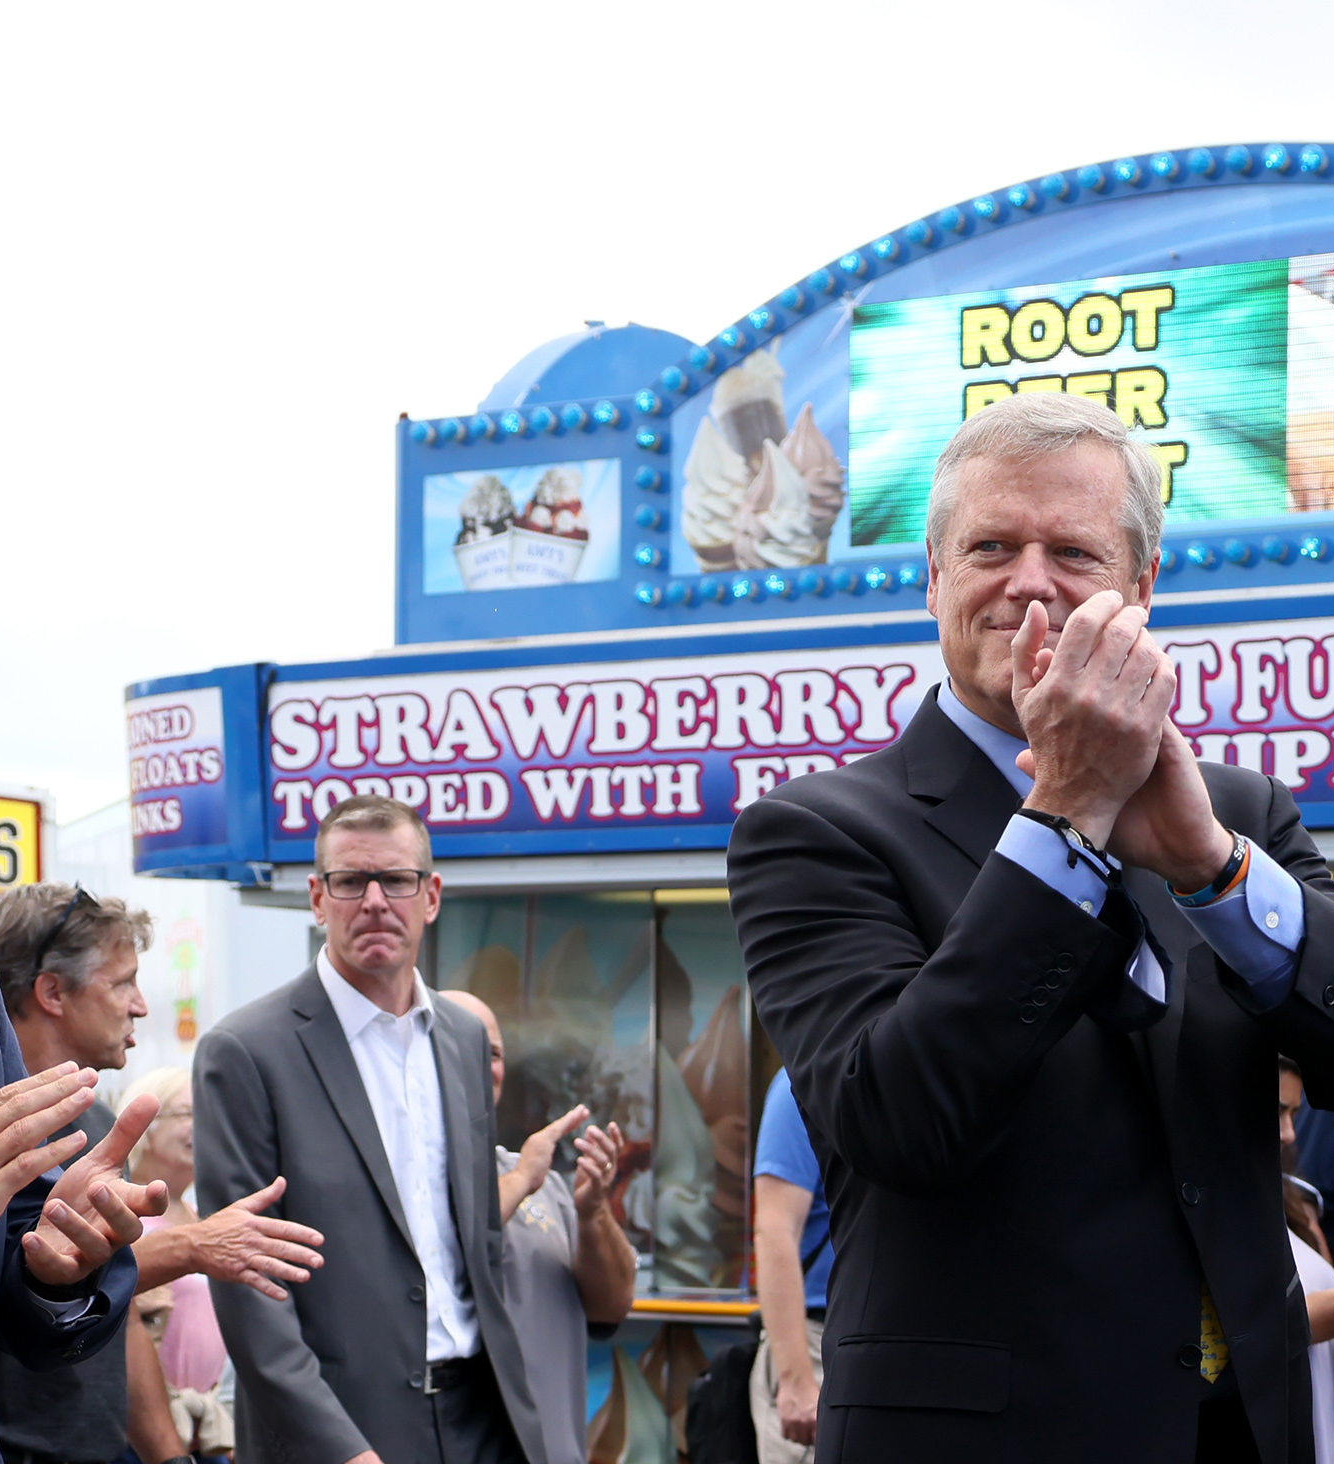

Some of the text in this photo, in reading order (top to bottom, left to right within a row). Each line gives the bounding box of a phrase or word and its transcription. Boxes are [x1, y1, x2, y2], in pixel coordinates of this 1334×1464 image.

[961, 284, 1175, 369] ROOT
[268, 663, 915, 771] STRAWBERRY
[521, 760, 703, 822] WITH
